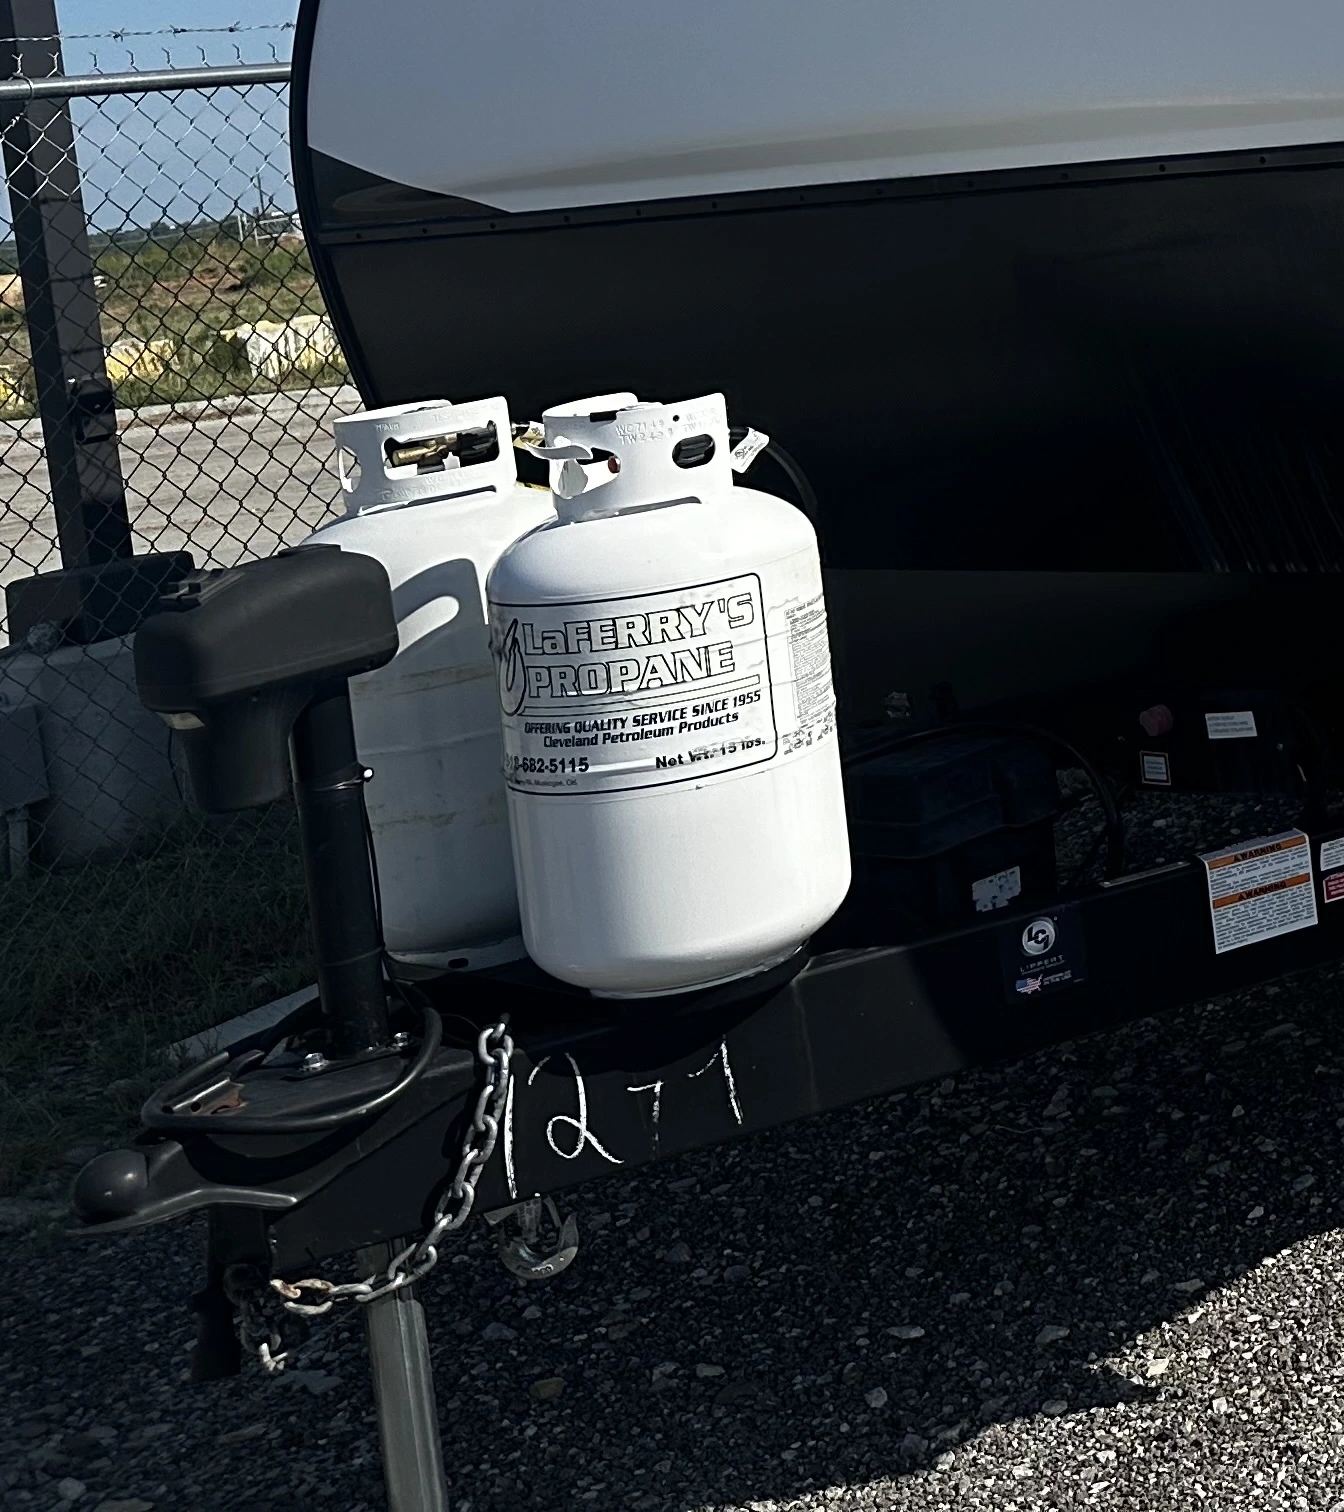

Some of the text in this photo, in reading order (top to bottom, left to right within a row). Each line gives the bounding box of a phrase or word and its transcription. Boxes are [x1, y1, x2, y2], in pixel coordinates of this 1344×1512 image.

[522, 593, 754, 656] LaFERRY'S
[526, 641, 734, 699] PROPANE
[524, 689, 762, 735] OFFERING QUALITY SERVICE SINCE 1955
[543, 710, 740, 748] Cleveland Petroleum Products
[1241, 843, 1282, 860] WARNING
[1246, 881, 1287, 899] WARNING
